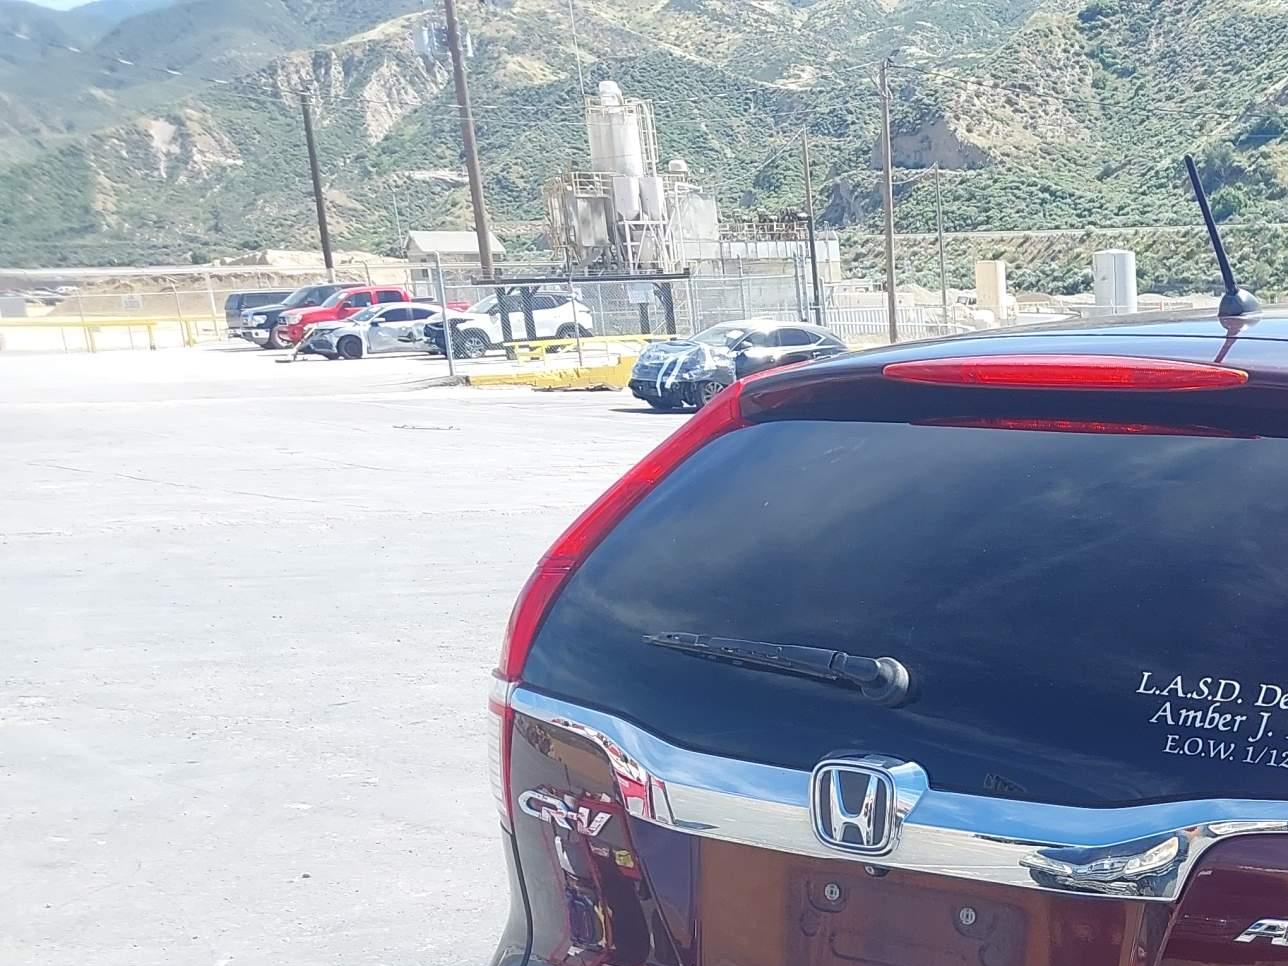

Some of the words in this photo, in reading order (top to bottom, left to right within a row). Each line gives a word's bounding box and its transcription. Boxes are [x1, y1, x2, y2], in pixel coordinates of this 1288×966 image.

[1136, 671, 1243, 704] L.A.S.D.
[1149, 701, 1247, 732] Amber
[1247, 712, 1273, 742] J.
[1162, 734, 1235, 761] E.O.W.
[518, 789, 612, 836] CR-V
